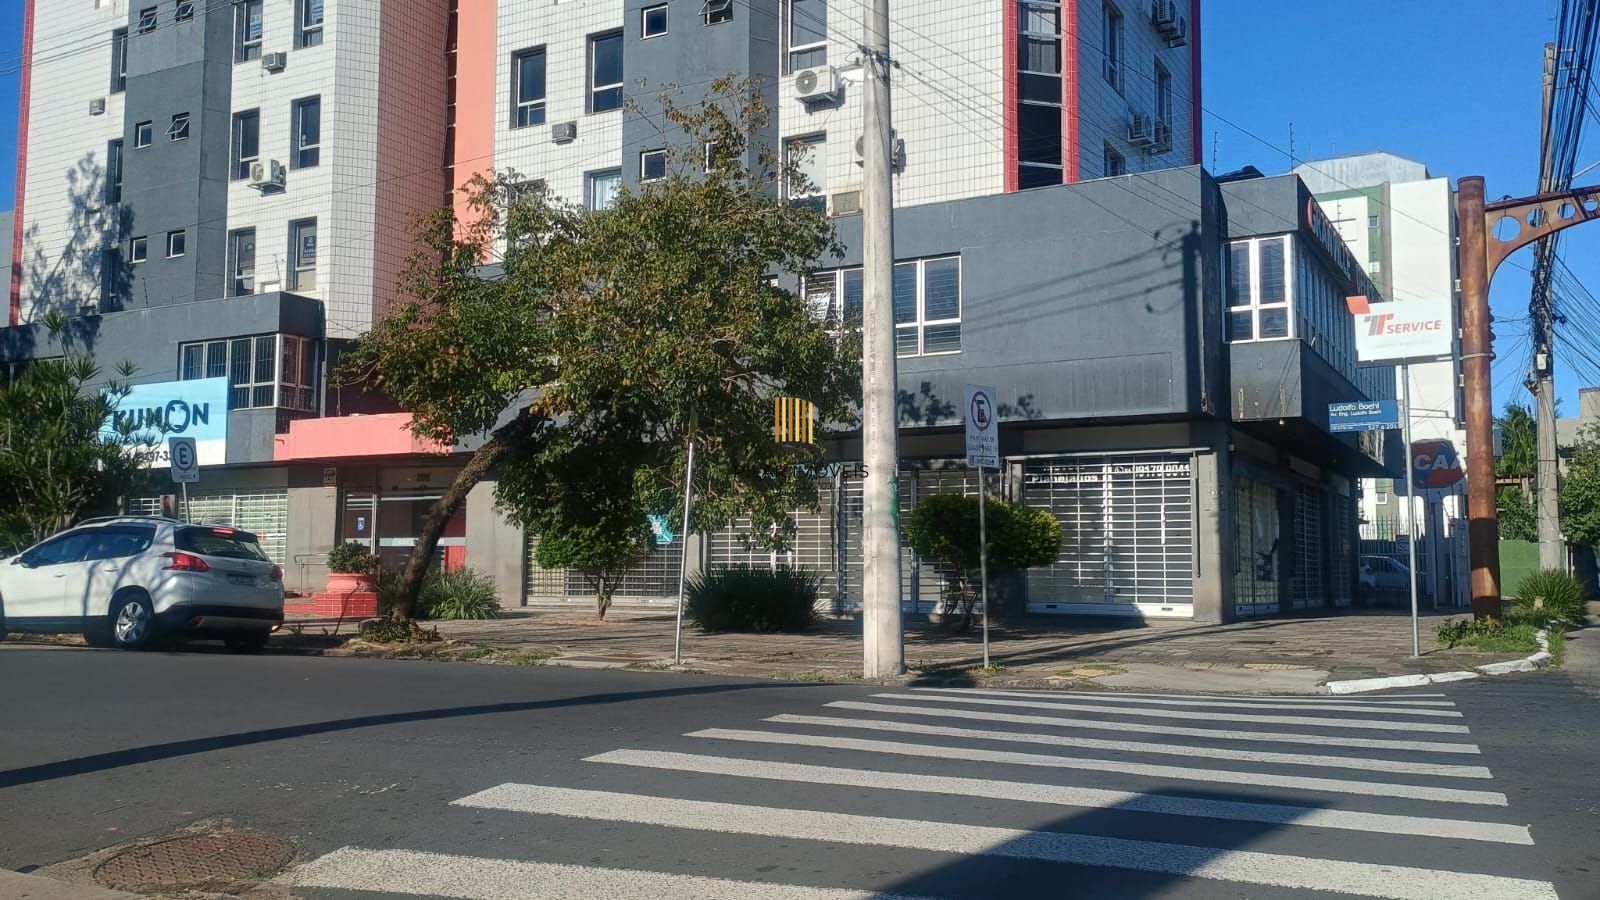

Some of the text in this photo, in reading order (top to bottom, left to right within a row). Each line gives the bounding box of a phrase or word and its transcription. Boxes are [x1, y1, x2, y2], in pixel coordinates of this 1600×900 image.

[1386, 320, 1442, 335] SERVICE
[1329, 402, 1380, 412] Ludolfo Boehl
[112, 400, 209, 434] KUMON
[179, 447, 188, 465] E
